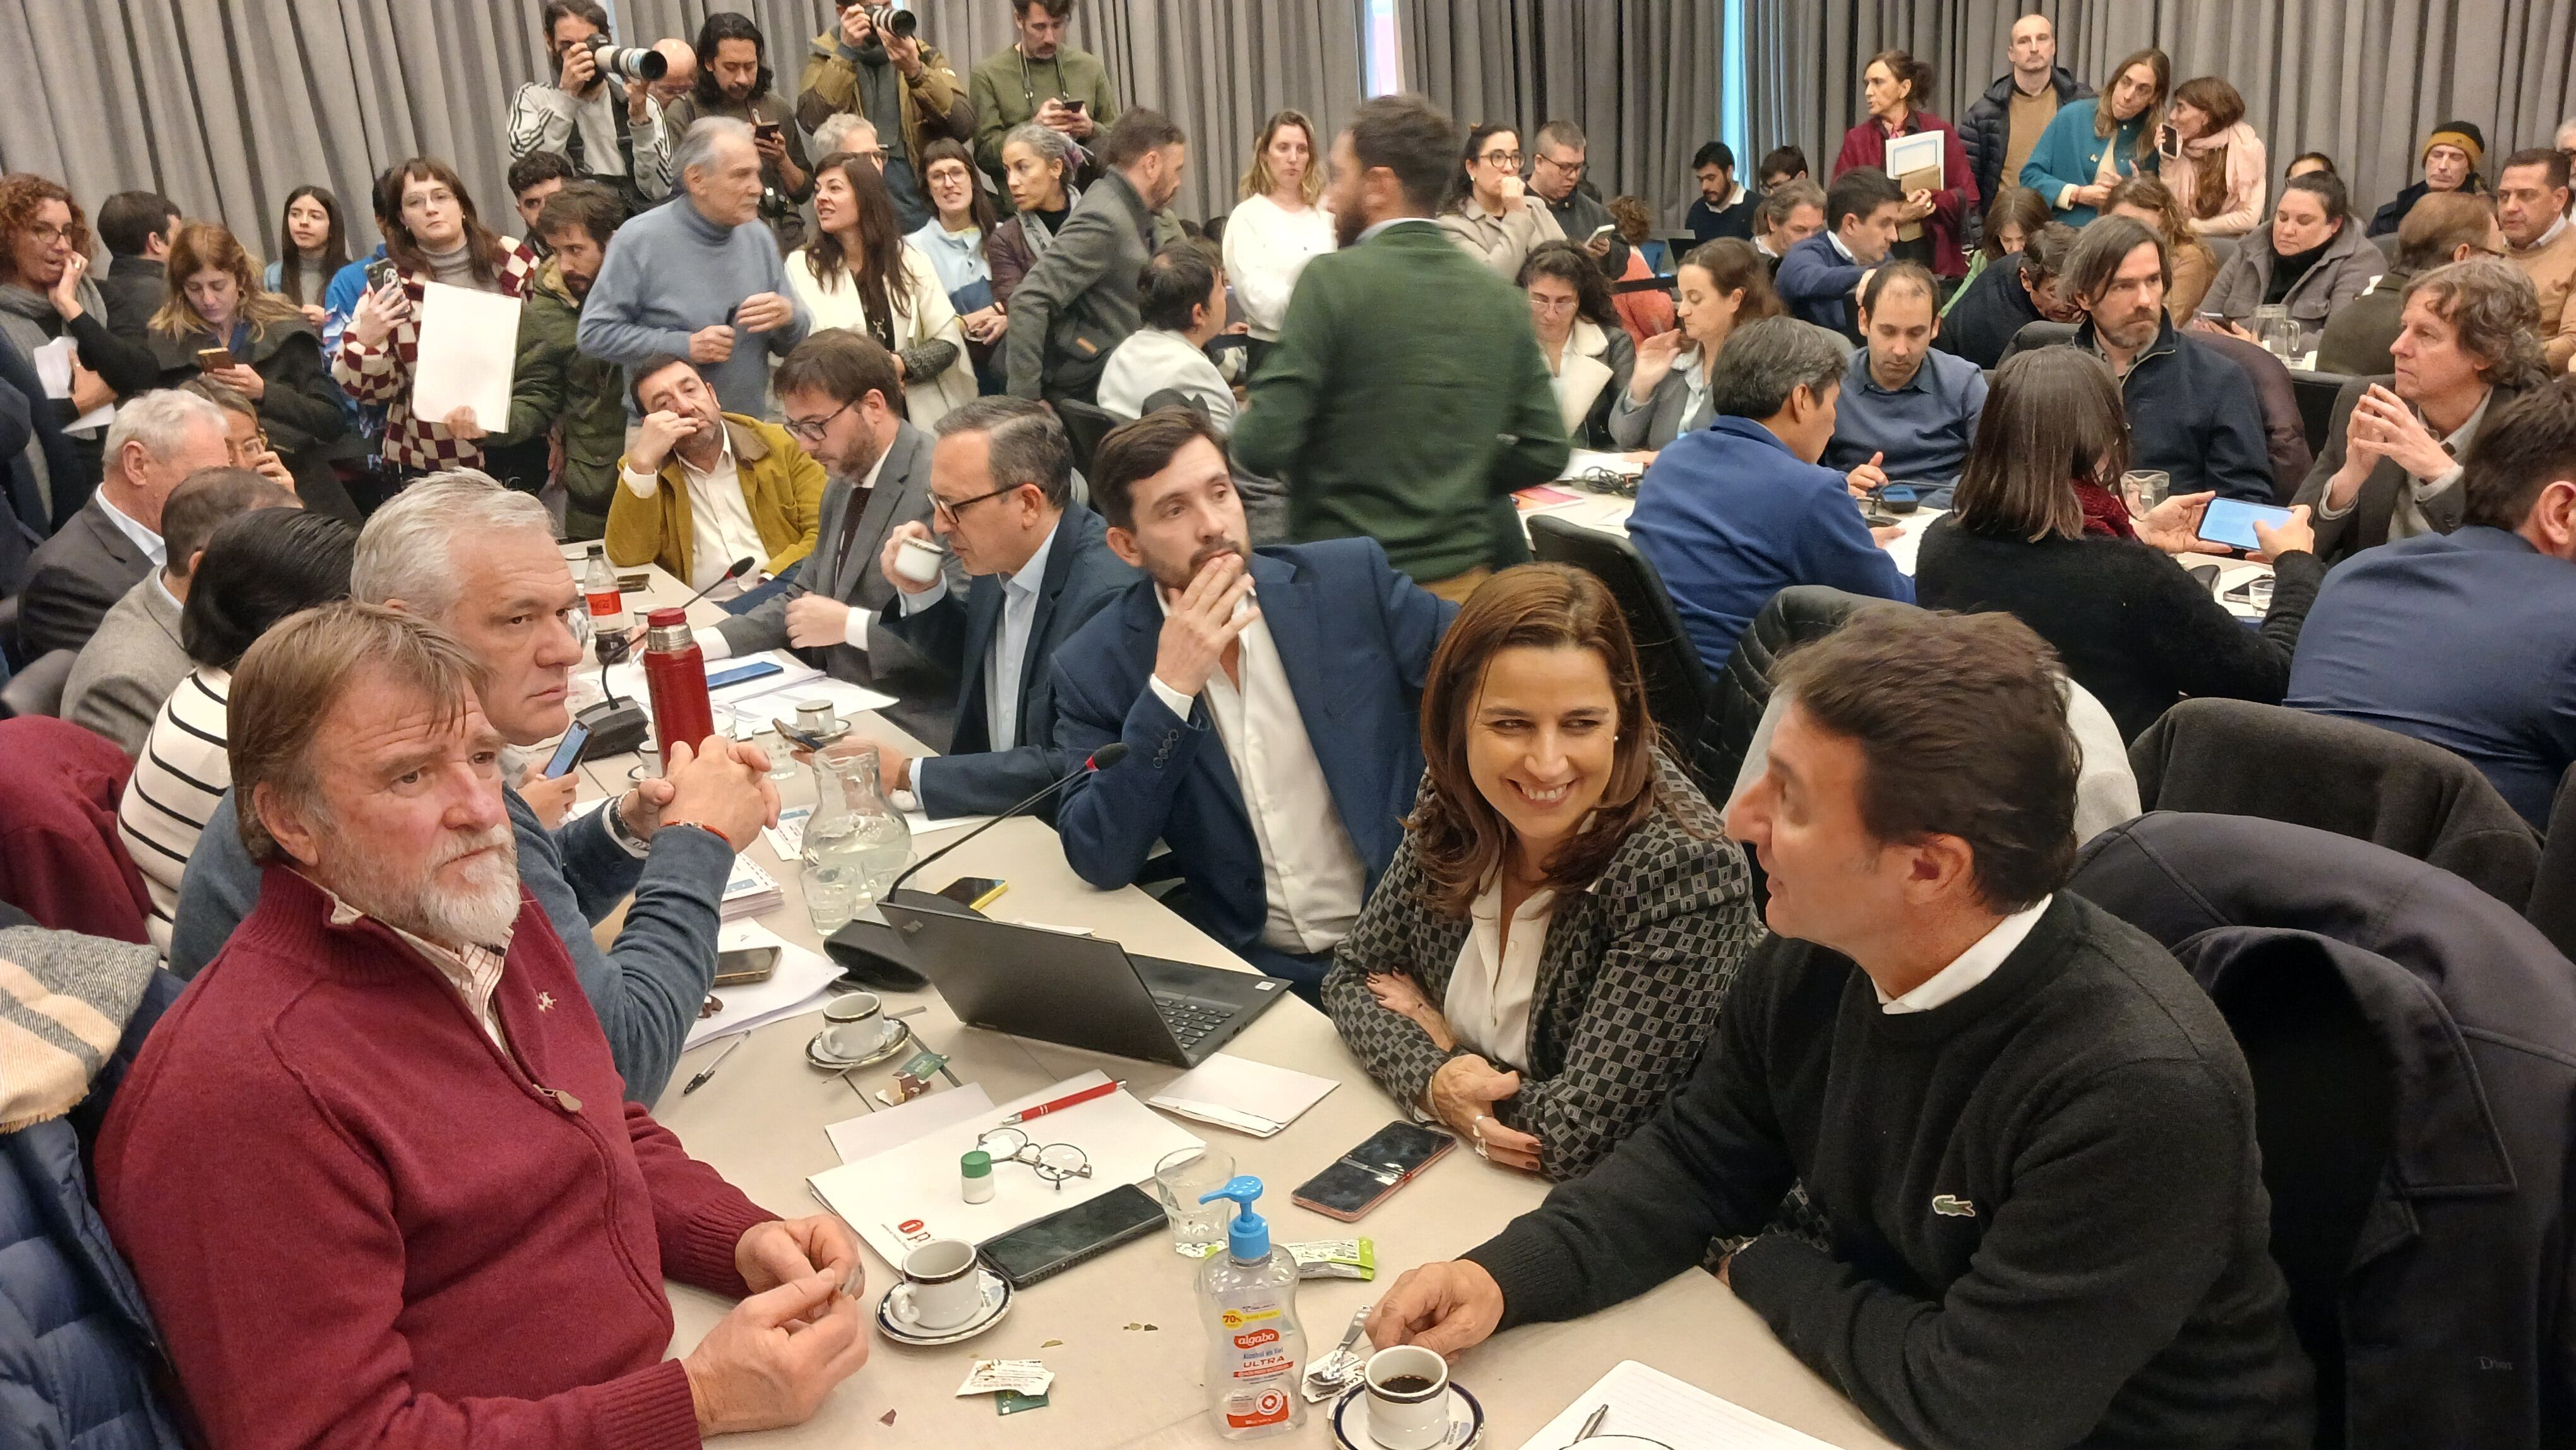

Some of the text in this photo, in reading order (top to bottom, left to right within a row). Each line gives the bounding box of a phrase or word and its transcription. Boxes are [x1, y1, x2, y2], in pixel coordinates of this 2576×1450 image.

[1238, 1333, 1275, 1346] algabo
[1243, 1355, 1285, 1367] ULTRA
[2478, 1356, 2513, 1370] Dior
